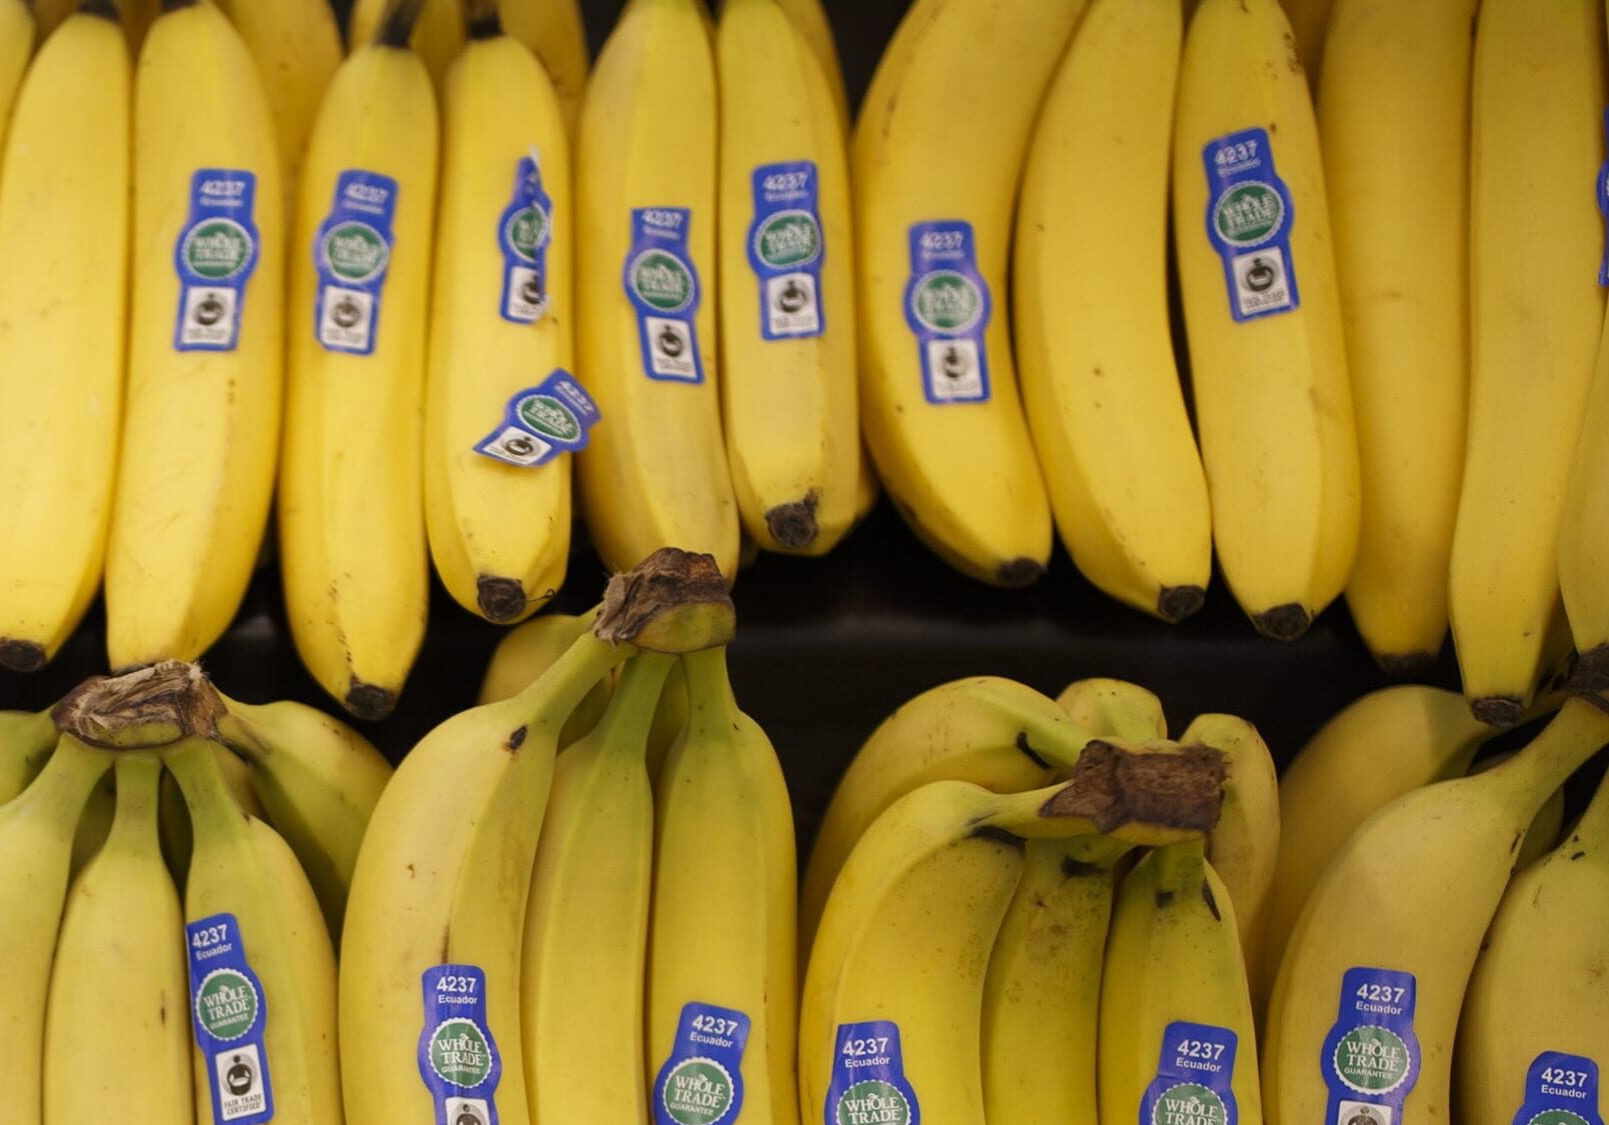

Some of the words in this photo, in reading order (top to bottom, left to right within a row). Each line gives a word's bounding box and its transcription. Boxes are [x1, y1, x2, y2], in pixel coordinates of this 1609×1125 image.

[1214, 139, 1258, 167] 4237
[192, 923, 227, 948] 4237
[196, 942, 232, 961] Ecuador
[436, 975, 476, 993] 4237
[1356, 983, 1405, 1001] 4237
[203, 985, 246, 1005] WHOLE
[438, 995, 478, 1005] Ecuador
[208, 1001, 250, 1020] TRADE
[1355, 1001, 1402, 1015] Ecuador
[692, 1014, 739, 1037] 4237
[437, 1038, 482, 1054] WHOLE
[690, 1032, 733, 1048] Ecuador
[843, 1037, 888, 1056] 4237
[1177, 1039, 1225, 1060] 4237
[1346, 1040, 1400, 1059] WHOLE
[439, 1051, 483, 1067] TRADE
[845, 1056, 891, 1068] Ecuador
[1175, 1057, 1222, 1072] Ecuador
[1346, 1054, 1399, 1072] TRADE
[1343, 1067, 1393, 1079] GUARANTEE
[1541, 1067, 1588, 1088] 4237
[675, 1075, 726, 1096] WHOLE
[1540, 1084, 1588, 1099] Ecuador
[673, 1089, 720, 1108] TRADE
[845, 1096, 899, 1113] WHOLE
[848, 1109, 900, 1124] TRADE
[1165, 1098, 1218, 1118] WHOLE
